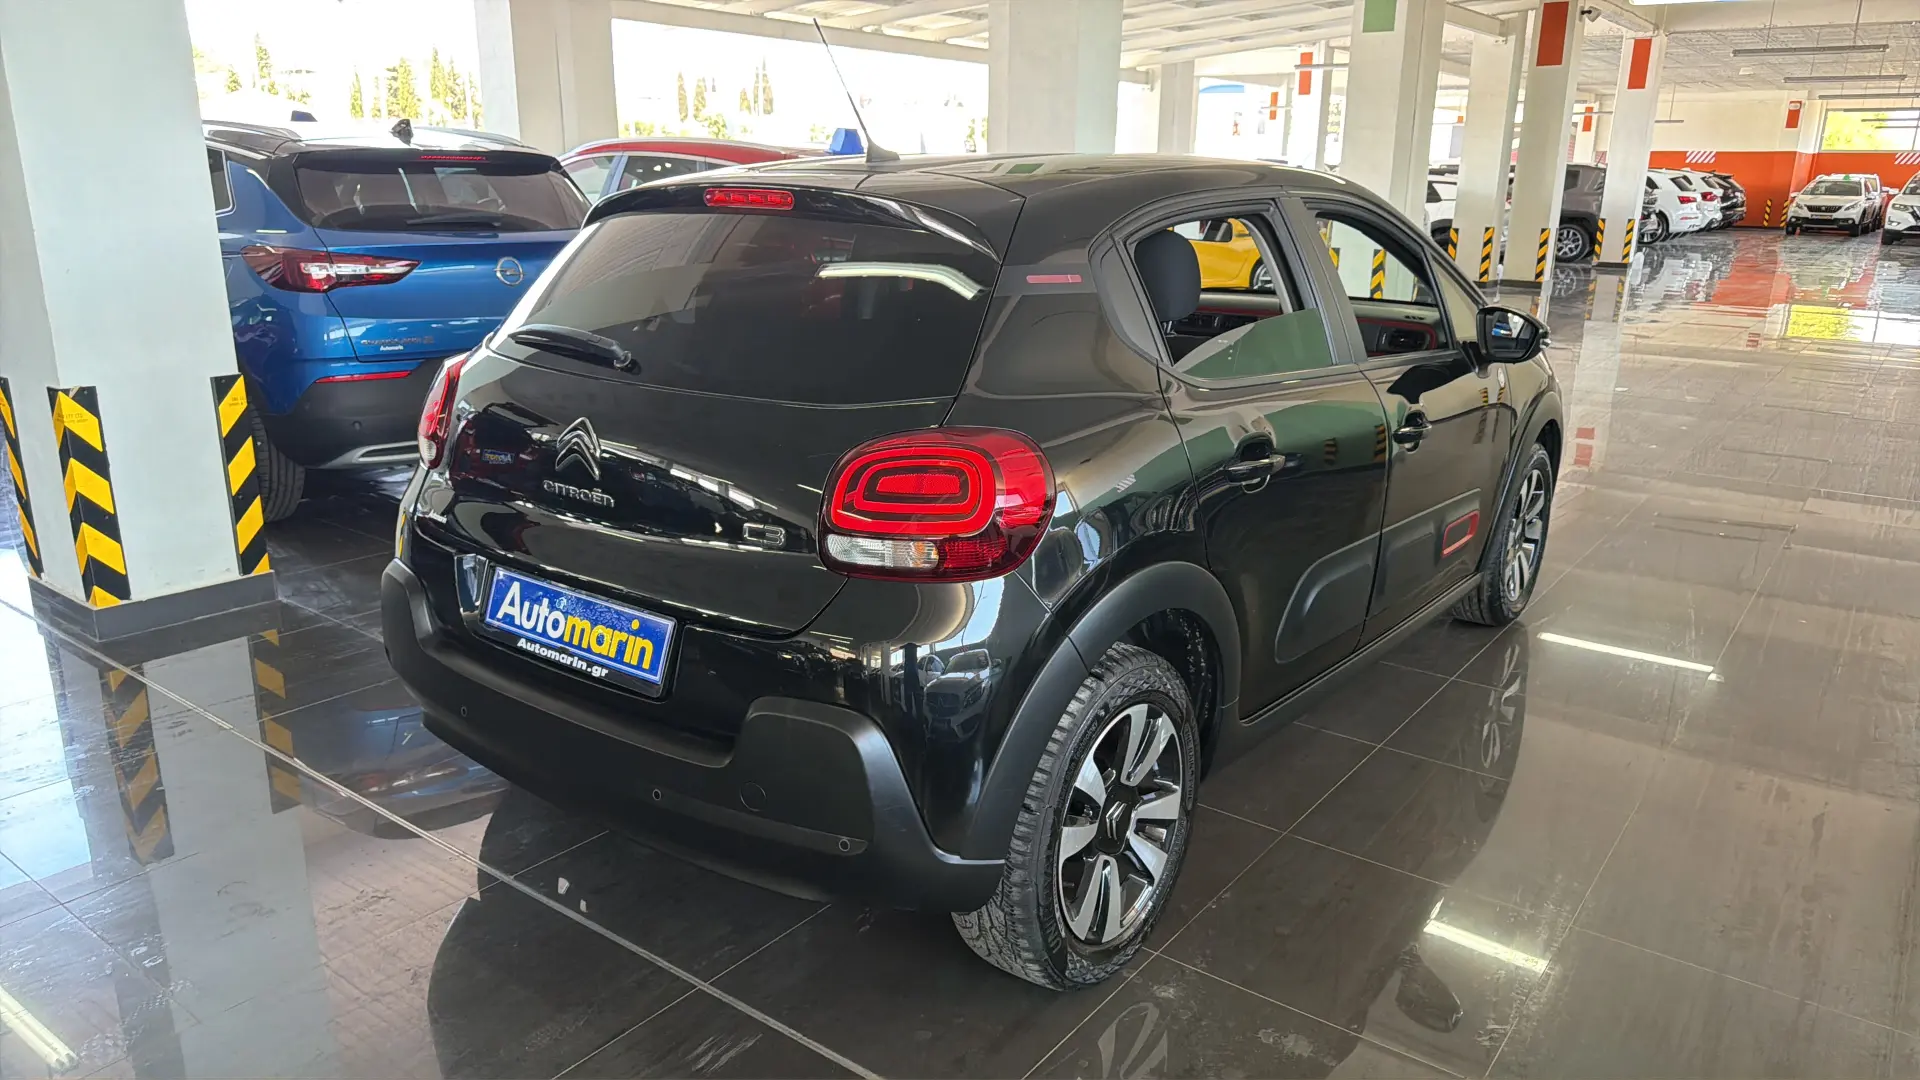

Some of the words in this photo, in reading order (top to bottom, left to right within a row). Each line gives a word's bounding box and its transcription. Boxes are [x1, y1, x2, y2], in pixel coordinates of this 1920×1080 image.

[742, 522, 786, 548] C3
[496, 581, 654, 670] Automarin
[517, 638, 609, 677] Automarin.gr
